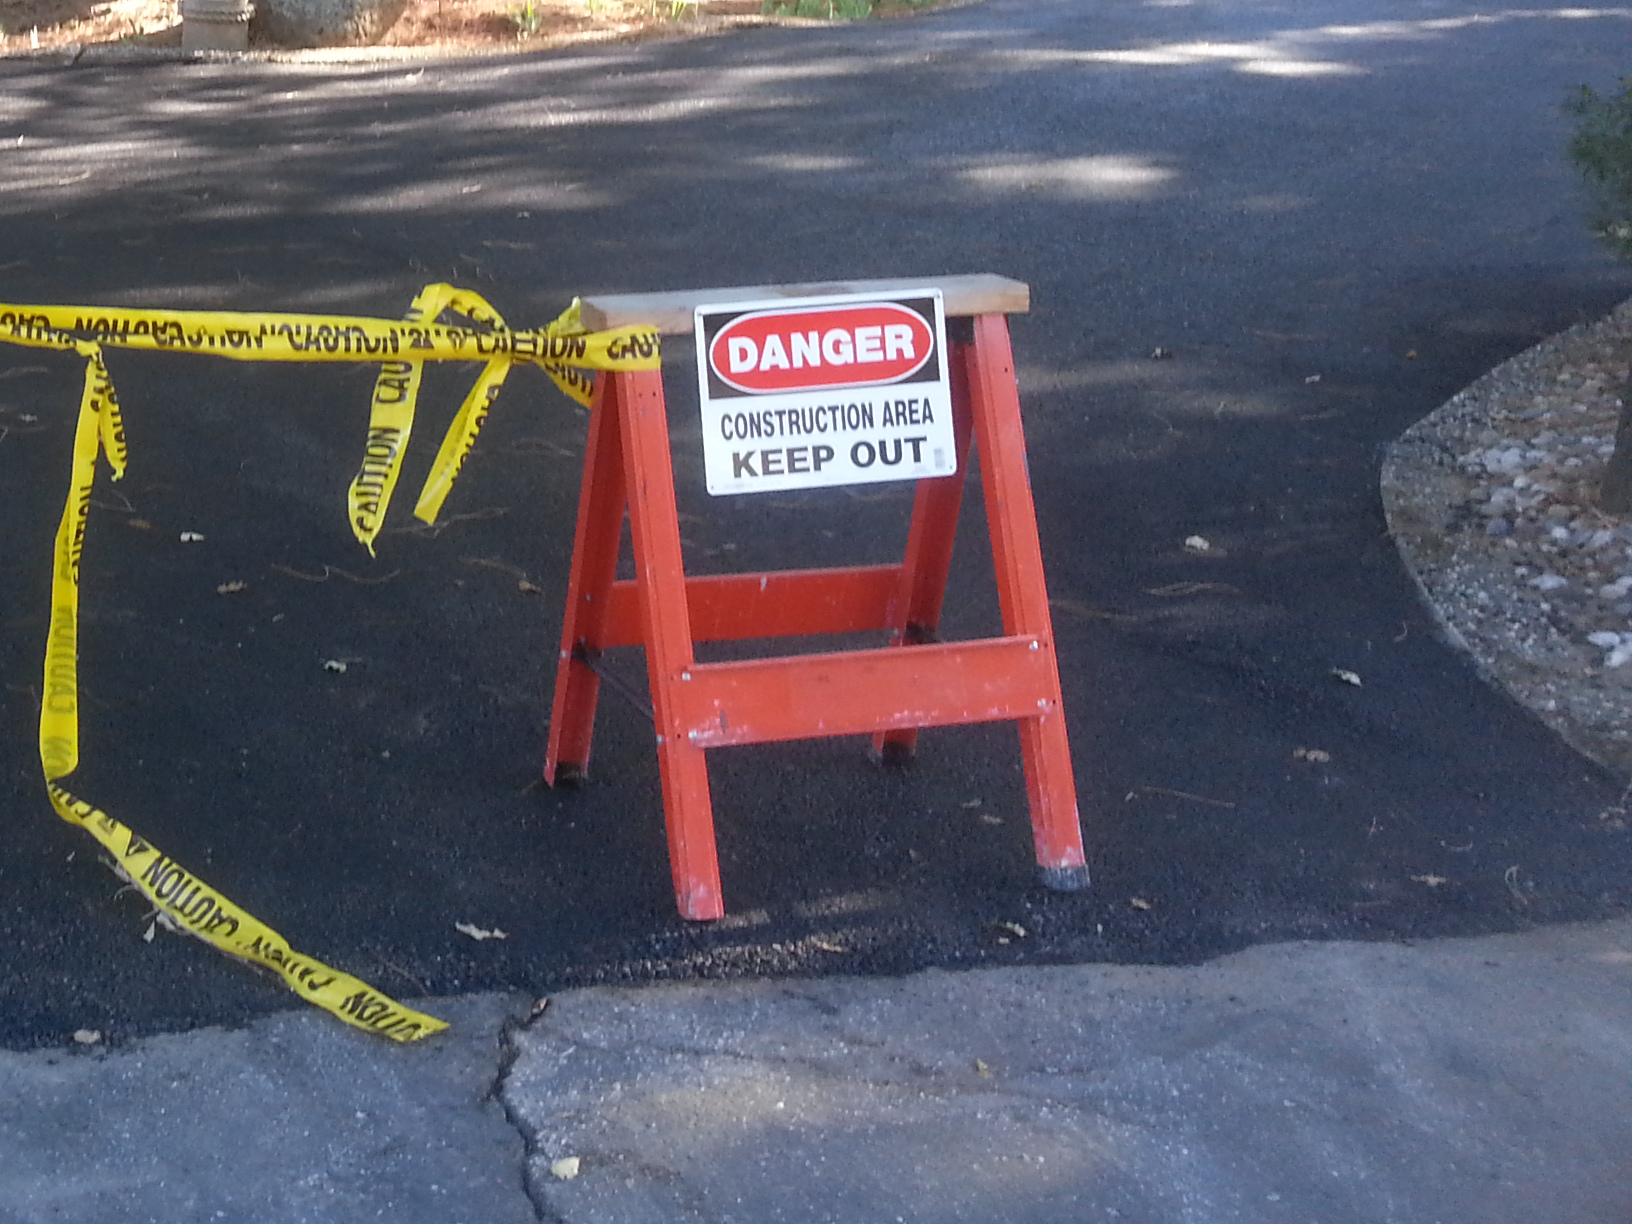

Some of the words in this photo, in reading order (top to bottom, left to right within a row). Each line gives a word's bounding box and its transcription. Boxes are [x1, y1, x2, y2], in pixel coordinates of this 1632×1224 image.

[727, 324, 916, 374] DANGER
[721, 403, 875, 441] CONSTRUCTION
[882, 397, 935, 427] AREA
[731, 444, 836, 479] KEEP
[849, 436, 928, 469] OUT
